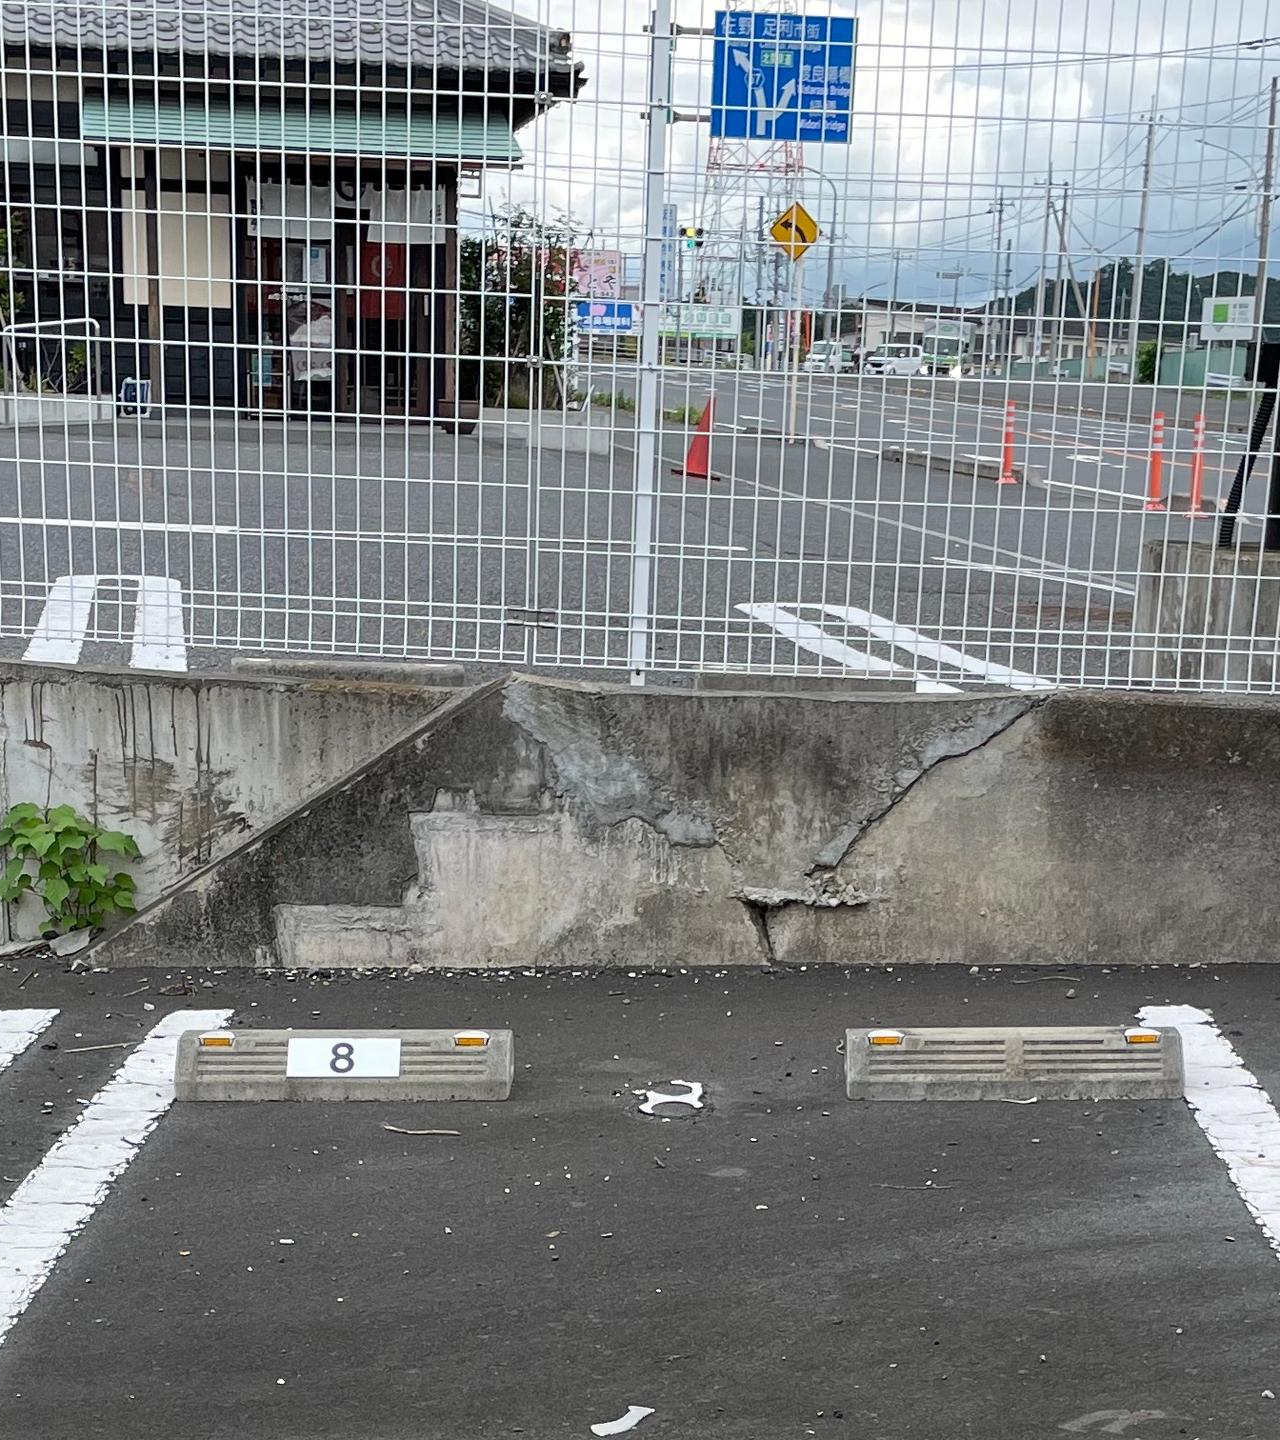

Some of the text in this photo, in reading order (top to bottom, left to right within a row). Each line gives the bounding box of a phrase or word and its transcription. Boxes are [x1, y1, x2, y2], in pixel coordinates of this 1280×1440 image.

[721, 15, 821, 40] 佐野 足利市街
[329, 1042, 355, 1074] 8
